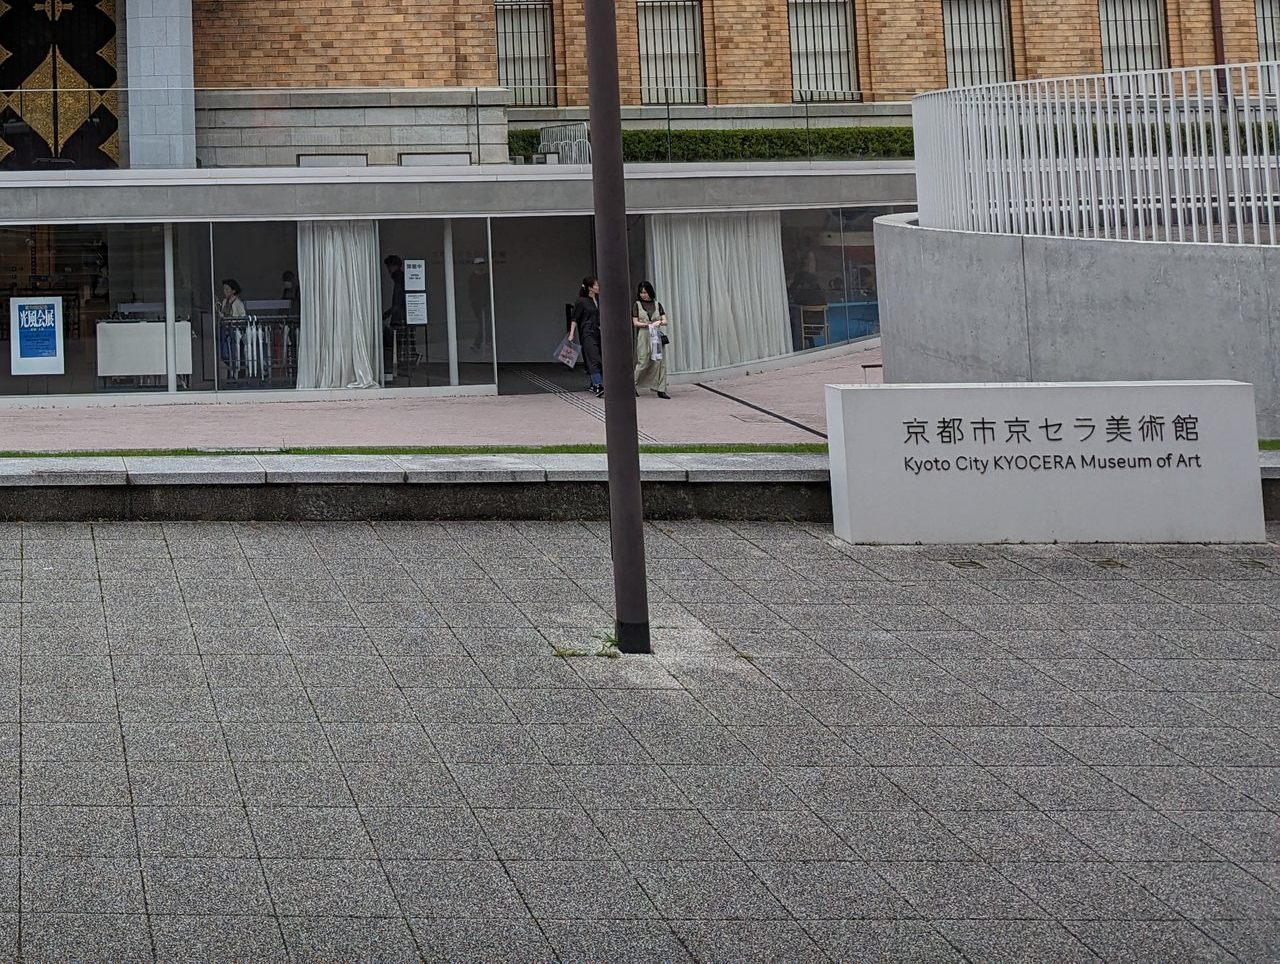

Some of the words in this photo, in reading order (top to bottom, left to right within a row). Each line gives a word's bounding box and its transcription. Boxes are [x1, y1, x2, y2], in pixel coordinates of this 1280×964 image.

[19, 309, 55, 328] 光風会展
[902, 413, 1198, 444] 京都市京セラ美術館
[904, 456, 950, 475] Kyoto
[955, 455, 988, 474] City
[993, 454, 1076, 471] KYOCERA
[1080, 454, 1151, 469] Museum
[1156, 452, 1173, 468] of
[1176, 453, 1201, 467] Art
